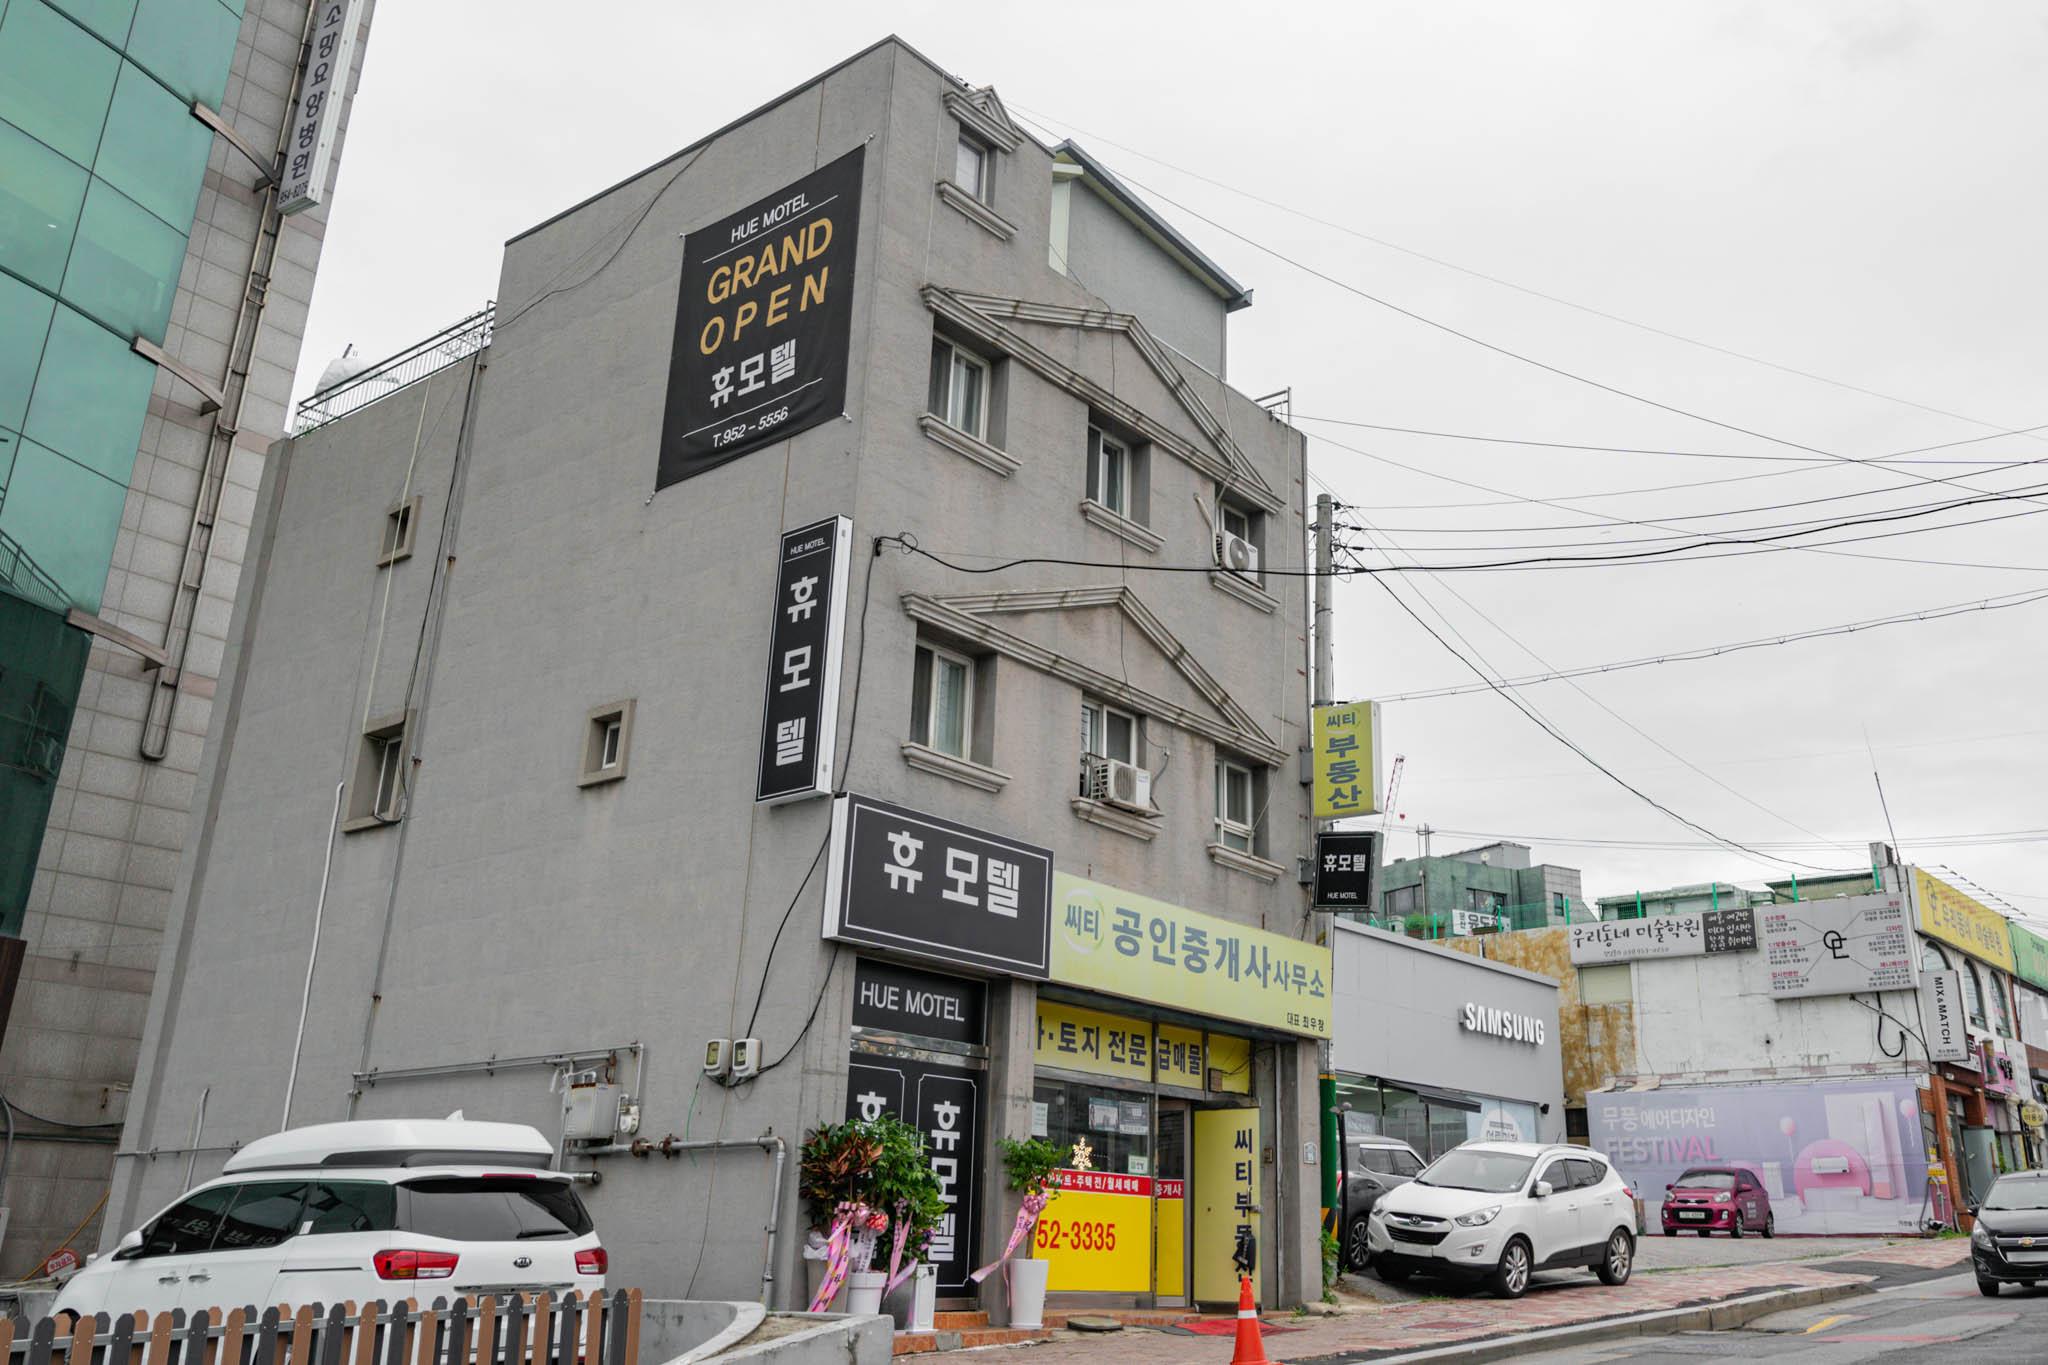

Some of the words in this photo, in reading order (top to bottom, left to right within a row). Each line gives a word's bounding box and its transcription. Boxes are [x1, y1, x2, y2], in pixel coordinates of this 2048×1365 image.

[291, 4, 341, 180] 소망요양병원
[731, 216, 759, 243] HUE
[762, 192, 810, 229] MOTEL
[707, 217, 833, 304] GRAND
[699, 265, 830, 356] OPEN
[709, 338, 797, 409] 휴모텔
[790, 543, 803, 555] HUE
[804, 537, 826, 551] MOTEL
[1326, 711, 1357, 728] 씨티
[1325, 733, 1363, 810] 부동산
[1323, 853, 1366, 873] 휴모텔
[1327, 892, 1339, 900] HUE
[1339, 892, 1358, 900] MOTEL
[1064, 903, 1100, 941] 씨티
[1572, 923, 1631, 949] 우리동네
[1635, 918, 1701, 944] 미술학원
[859, 981, 900, 1011] HUE
[905, 988, 966, 1023] MOTEL
[1286, 1012, 1301, 1027] 대표
[1464, 1001, 1545, 1046] SAMSUNG
[1107, 1030, 1147, 1068] 전문
[1159, 1038, 1202, 1076] 급매물
[1606, 1135, 1721, 1164] FESTIVAL
